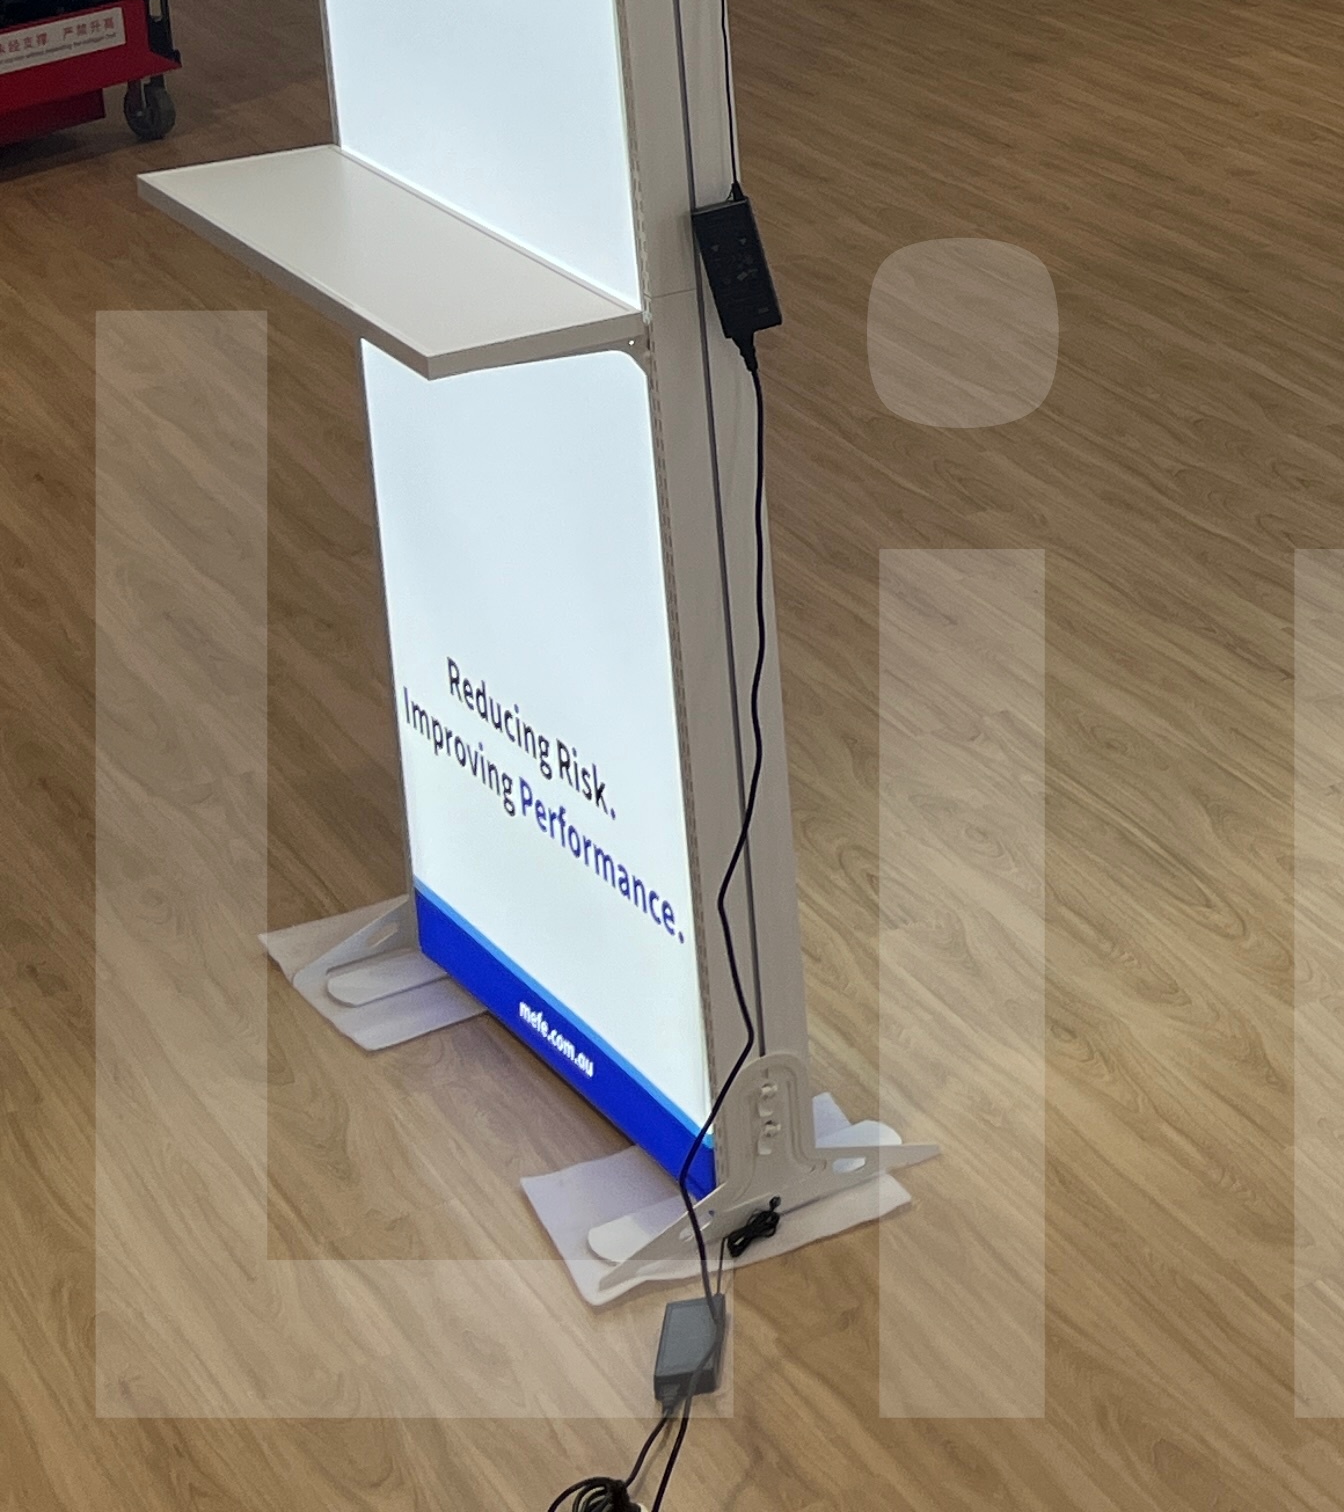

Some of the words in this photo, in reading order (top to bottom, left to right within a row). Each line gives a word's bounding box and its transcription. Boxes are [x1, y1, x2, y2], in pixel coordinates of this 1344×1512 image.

[403, 686, 516, 817] Improving
[519, 776, 684, 944] Performance.
[446, 656, 552, 780] Reducing
[556, 738, 616, 820] Risk.
[519, 1001, 594, 1078] mefe.com.au
